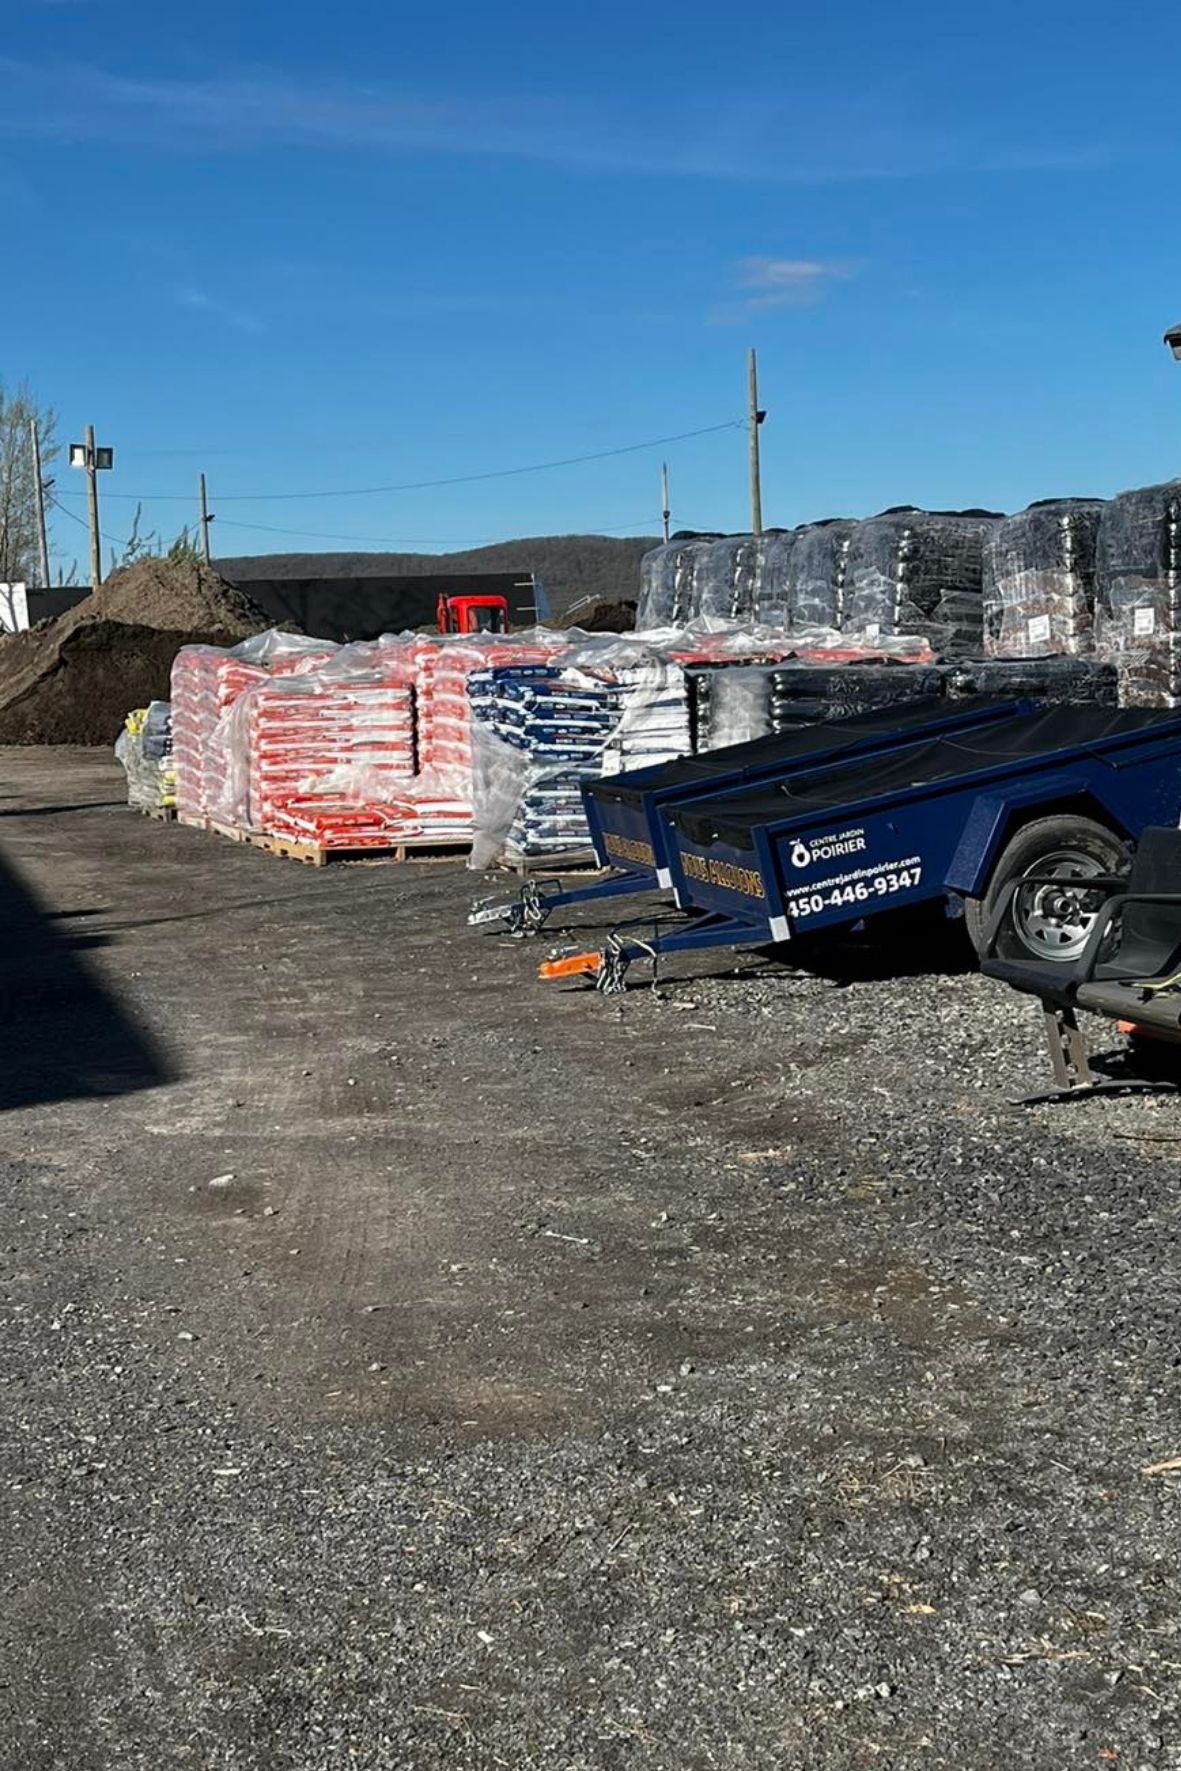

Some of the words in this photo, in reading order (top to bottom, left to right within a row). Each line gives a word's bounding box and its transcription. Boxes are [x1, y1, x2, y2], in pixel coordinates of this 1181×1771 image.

[809, 834, 838, 848] CENTRE
[838, 828, 865, 840] JARDIN
[811, 837, 867, 862] POIRIER
[785, 855, 921, 897] www.centrejardinpoirier.com
[787, 867, 922, 918] 450-446-9347
